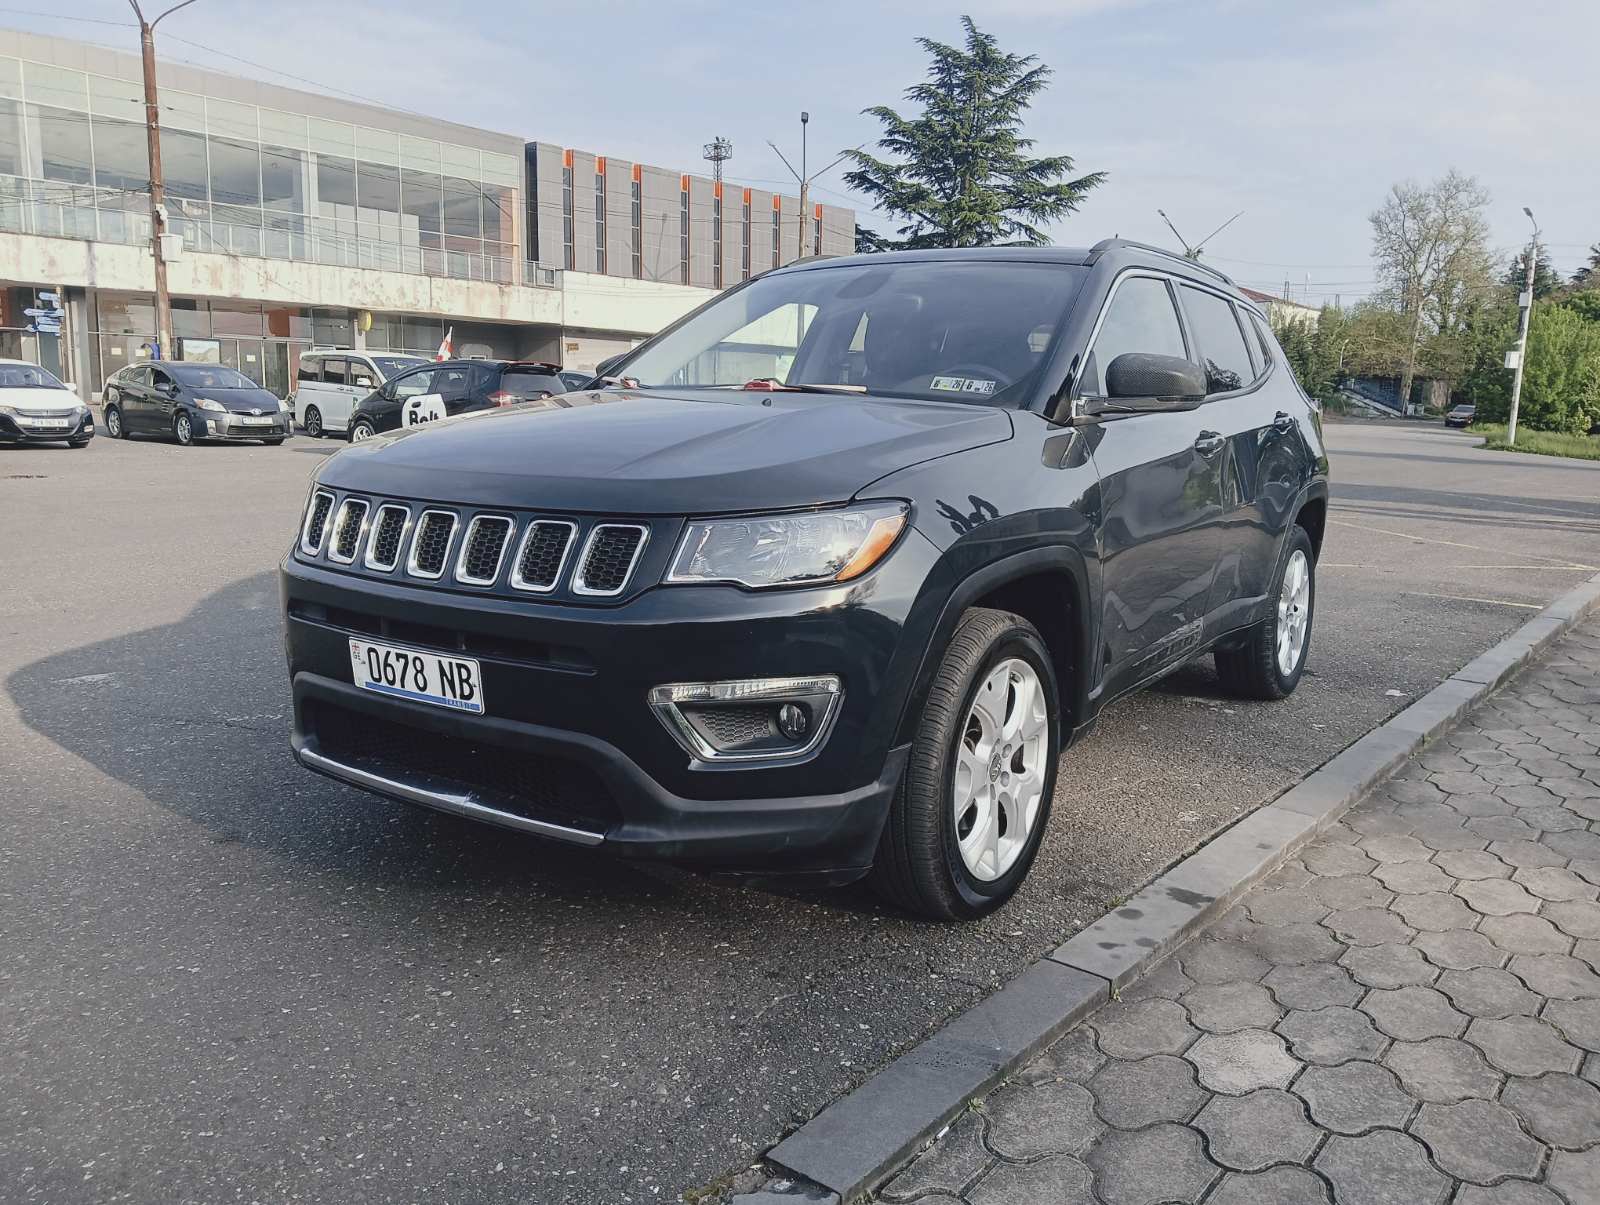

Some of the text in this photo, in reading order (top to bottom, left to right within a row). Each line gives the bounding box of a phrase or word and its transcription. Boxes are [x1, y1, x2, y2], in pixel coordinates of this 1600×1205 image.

[408, 410, 439, 426] Bolt
[367, 647, 475, 701] 0678 NB
